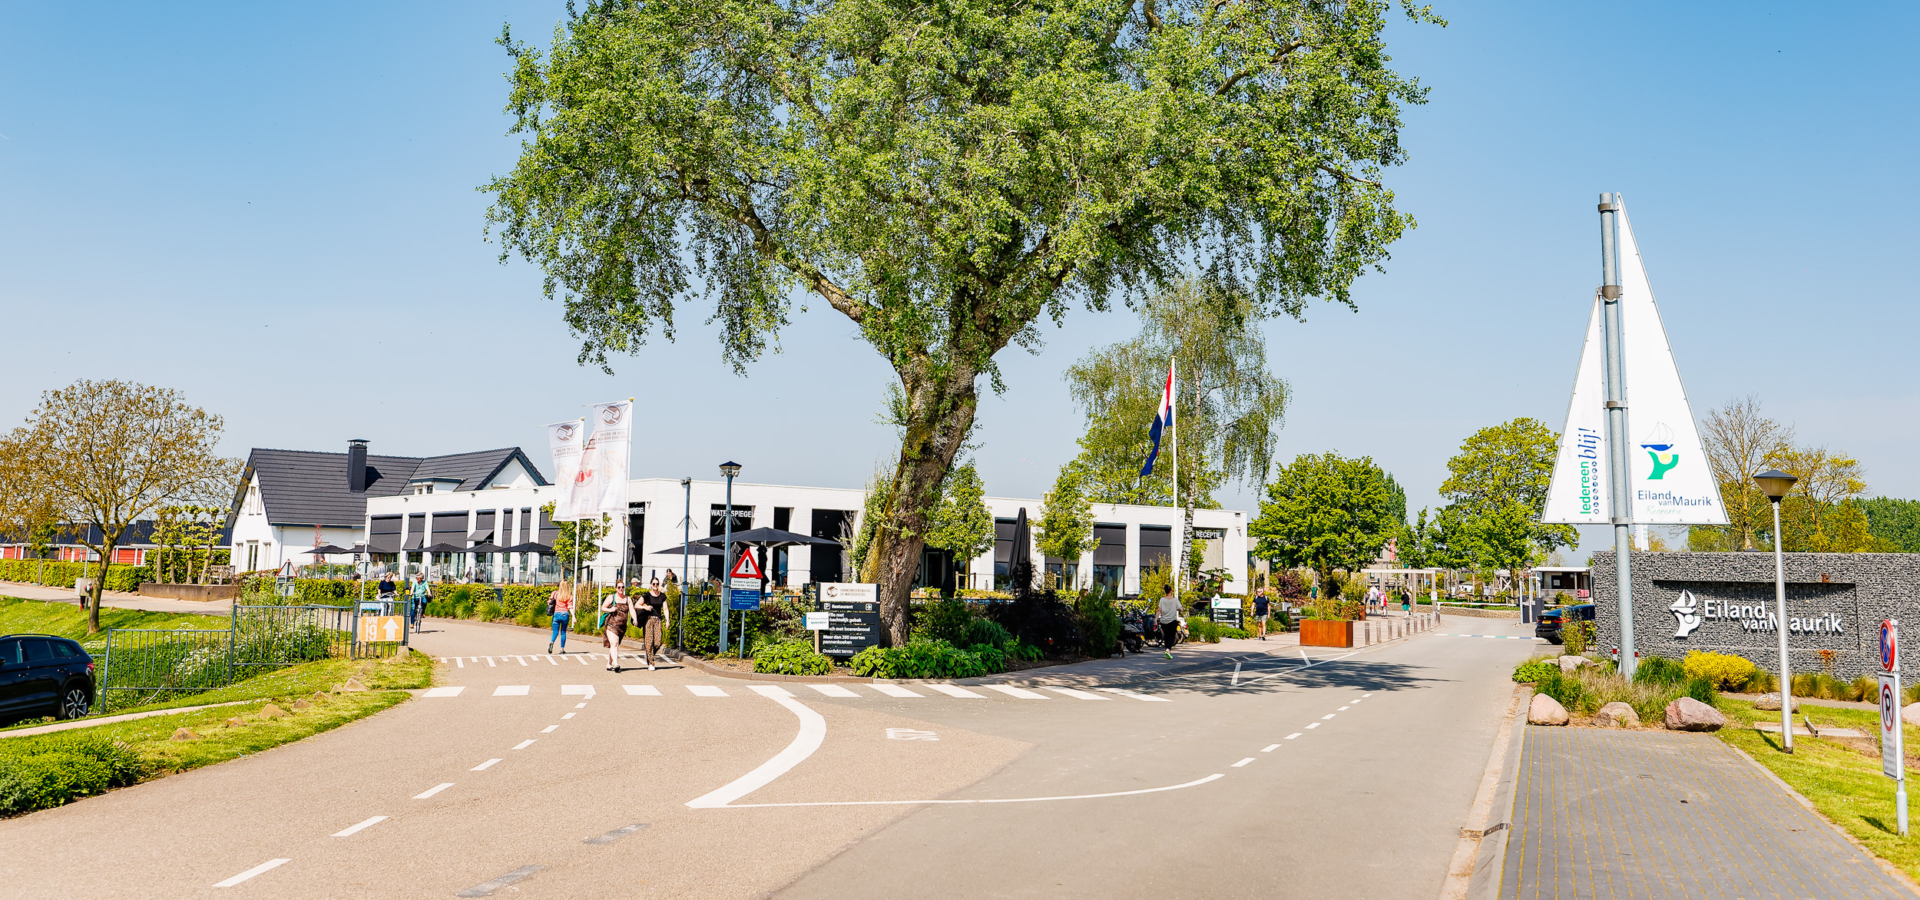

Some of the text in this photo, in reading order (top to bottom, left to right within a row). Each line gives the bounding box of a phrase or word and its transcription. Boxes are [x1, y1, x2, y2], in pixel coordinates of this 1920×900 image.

[1577, 427, 1602, 514] Iedereen blij!
[1638, 490, 1671, 500] Eiland
[1673, 496, 1712, 506] Maurik
[1704, 600, 1766, 619] Eiland
[1742, 618, 1768, 630] van
